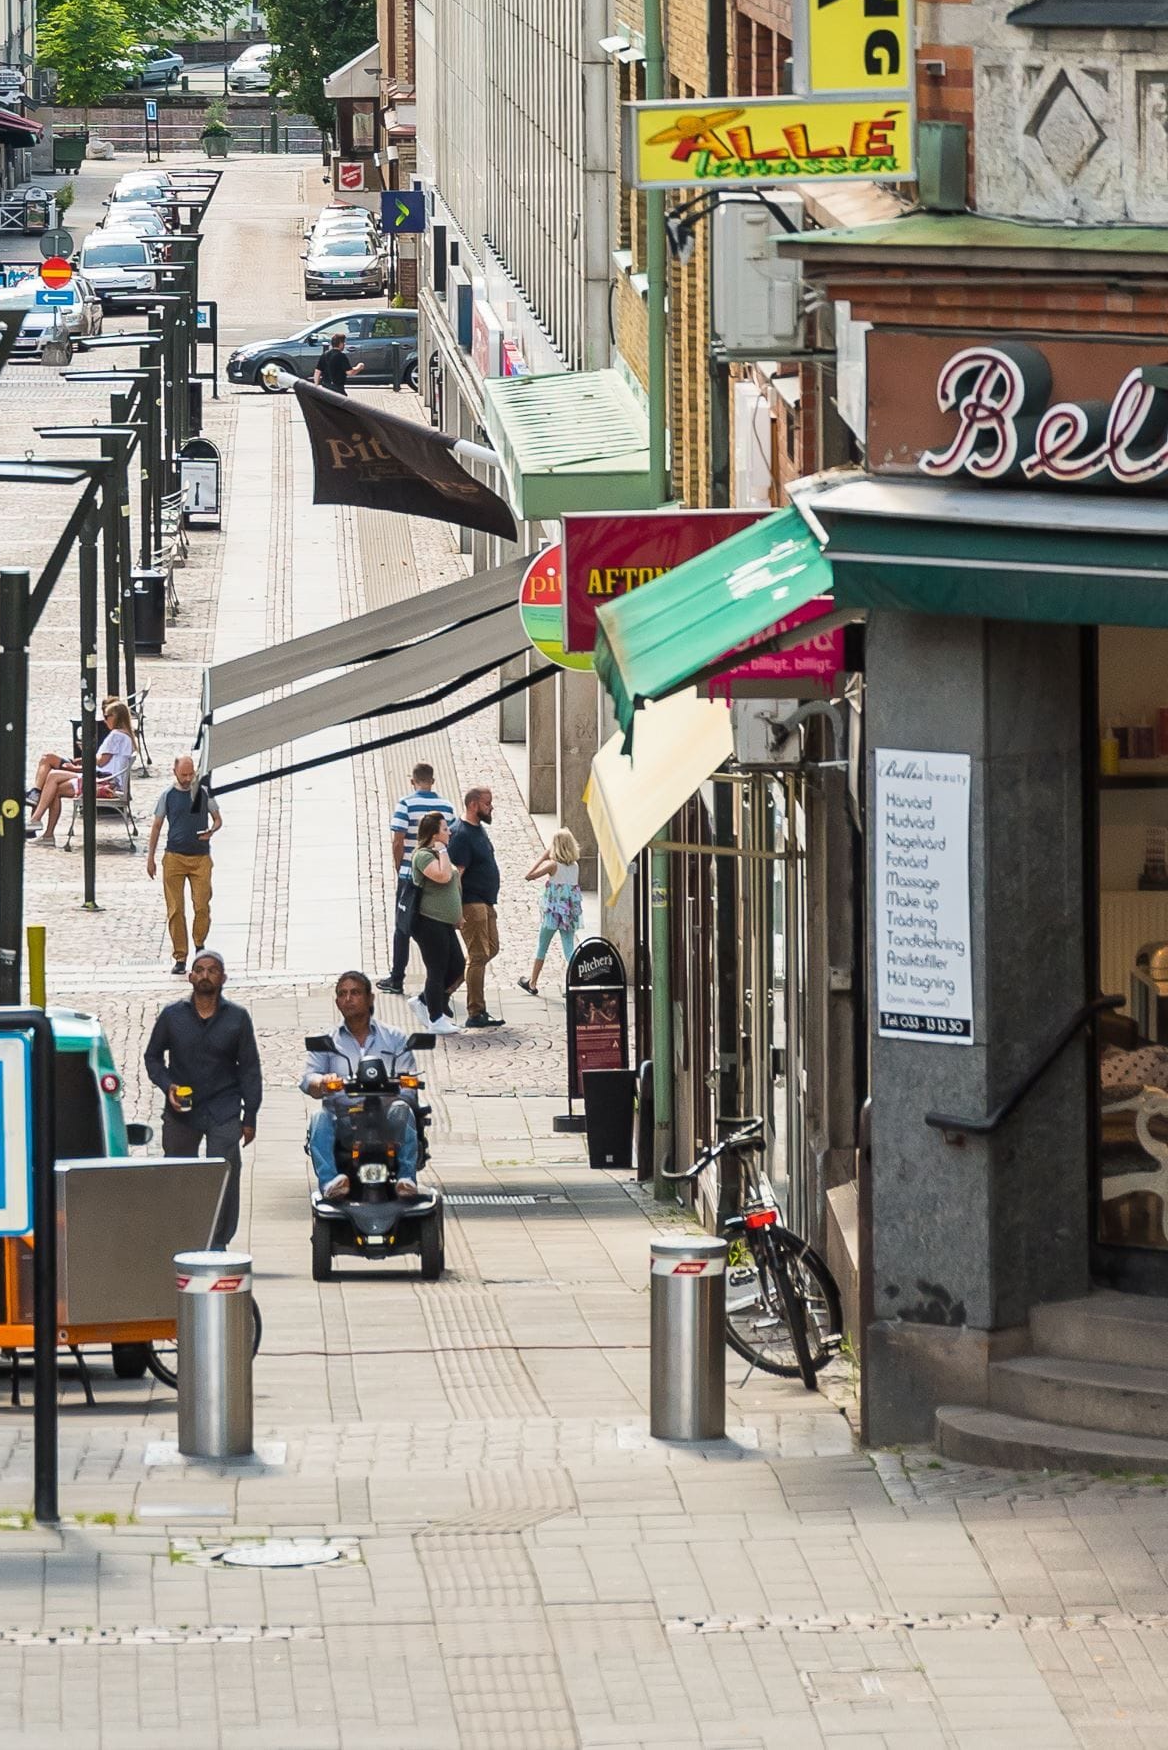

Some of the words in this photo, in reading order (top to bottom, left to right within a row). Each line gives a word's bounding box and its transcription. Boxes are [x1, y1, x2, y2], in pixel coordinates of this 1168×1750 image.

[671, 109, 904, 162] ALLÉ
[886, 870, 940, 895] Massage
[886, 890, 920, 908] Make
[923, 898, 939, 915] up
[910, 974, 955, 996] tagning
